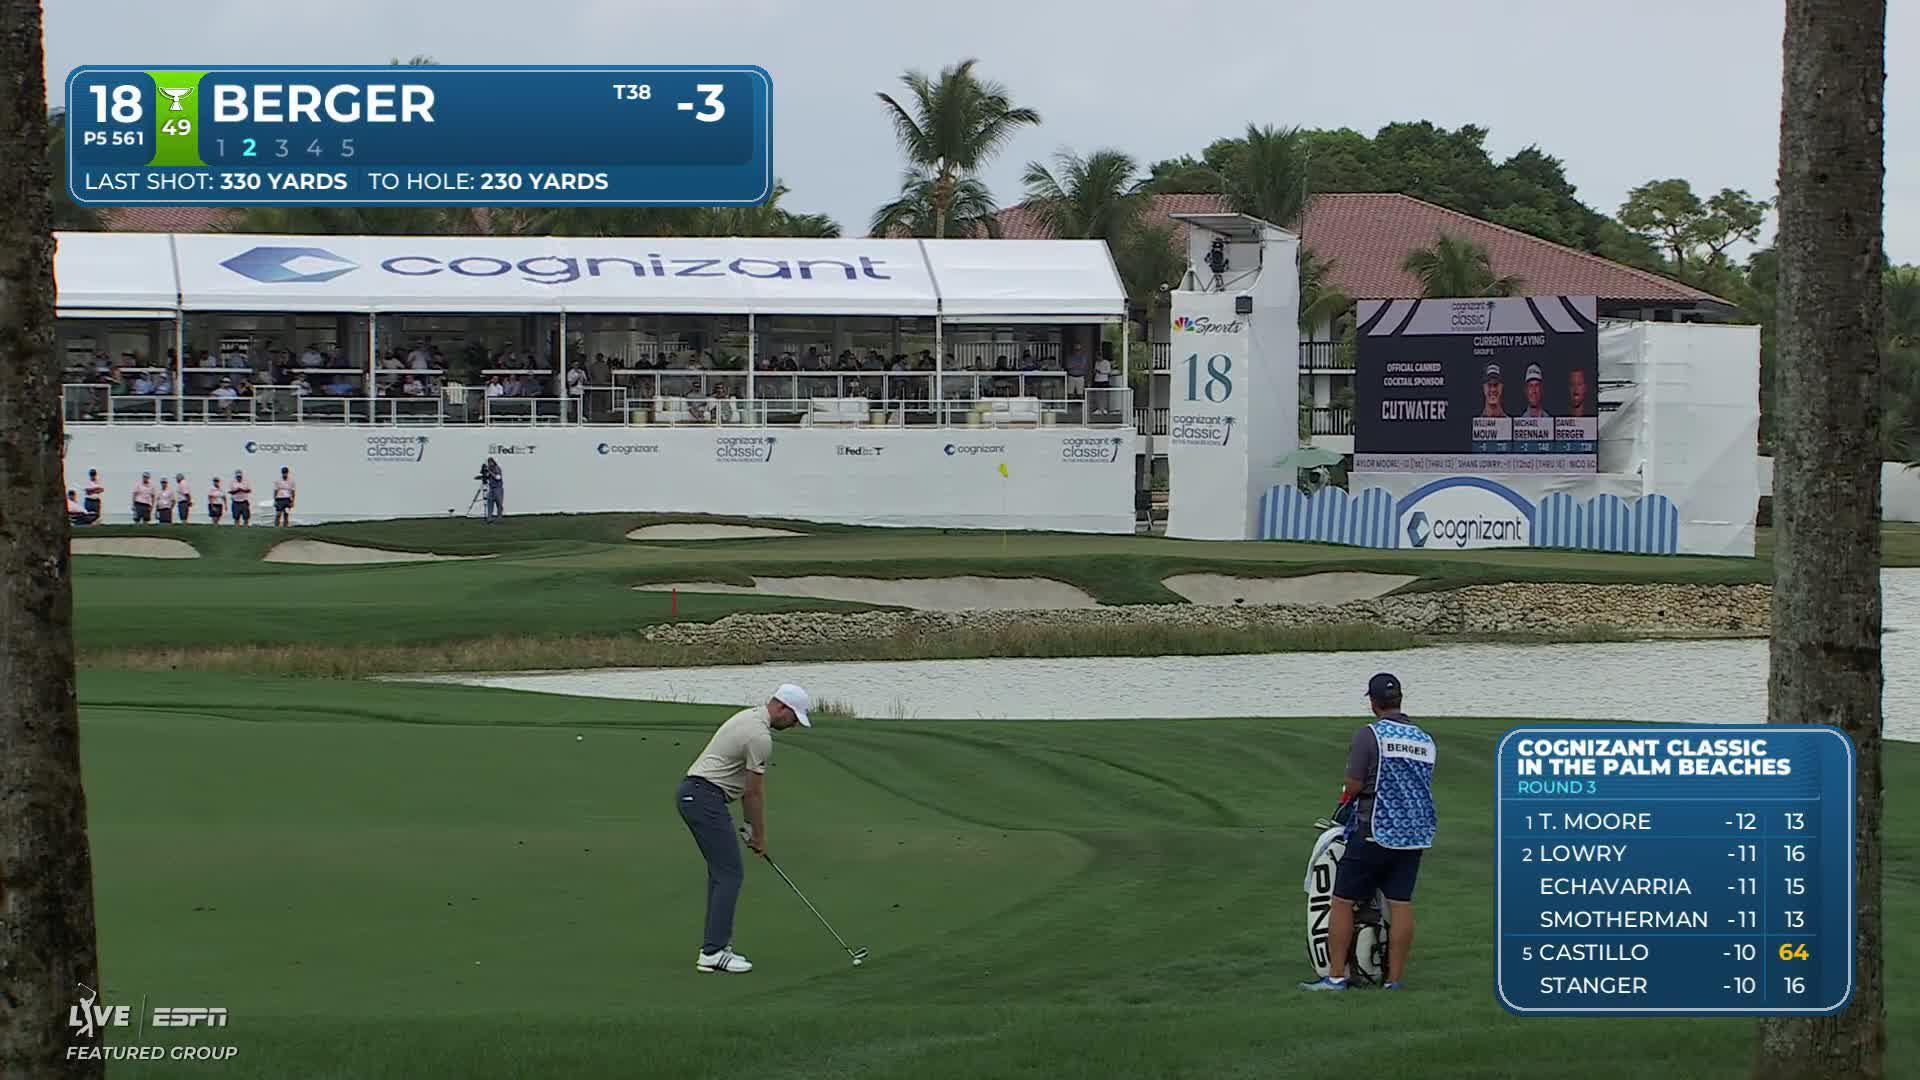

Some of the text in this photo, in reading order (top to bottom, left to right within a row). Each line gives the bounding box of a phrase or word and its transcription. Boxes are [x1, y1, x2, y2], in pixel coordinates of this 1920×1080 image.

[381, 252, 892, 283] cognizant
[1194, 316, 1243, 336] Sports
[1473, 335, 1545, 347] CURRENTLY PLAYING
[1386, 362, 1414, 373] OFFICIAL
[1182, 353, 1233, 404] 18
[1414, 376, 1445, 387] SPONSOR
[1382, 400, 1447, 420] CUTWATER
[1172, 415, 1221, 426] cognizant
[1172, 424, 1221, 440] classic
[1473, 429, 1498, 439] MOUW
[1514, 429, 1550, 439] BRENNAN
[1555, 429, 1585, 439] BERGER
[367, 444, 415, 457] classic
[611, 444, 659, 455] cognizant
[716, 444, 764, 458] classic
[957, 445, 1005, 456] cognizant
[1062, 446, 1110, 458] classic
[1433, 514, 1522, 548] cognizant
[1387, 742, 1428, 757] BERGER
[1310, 863, 1332, 968] PING
